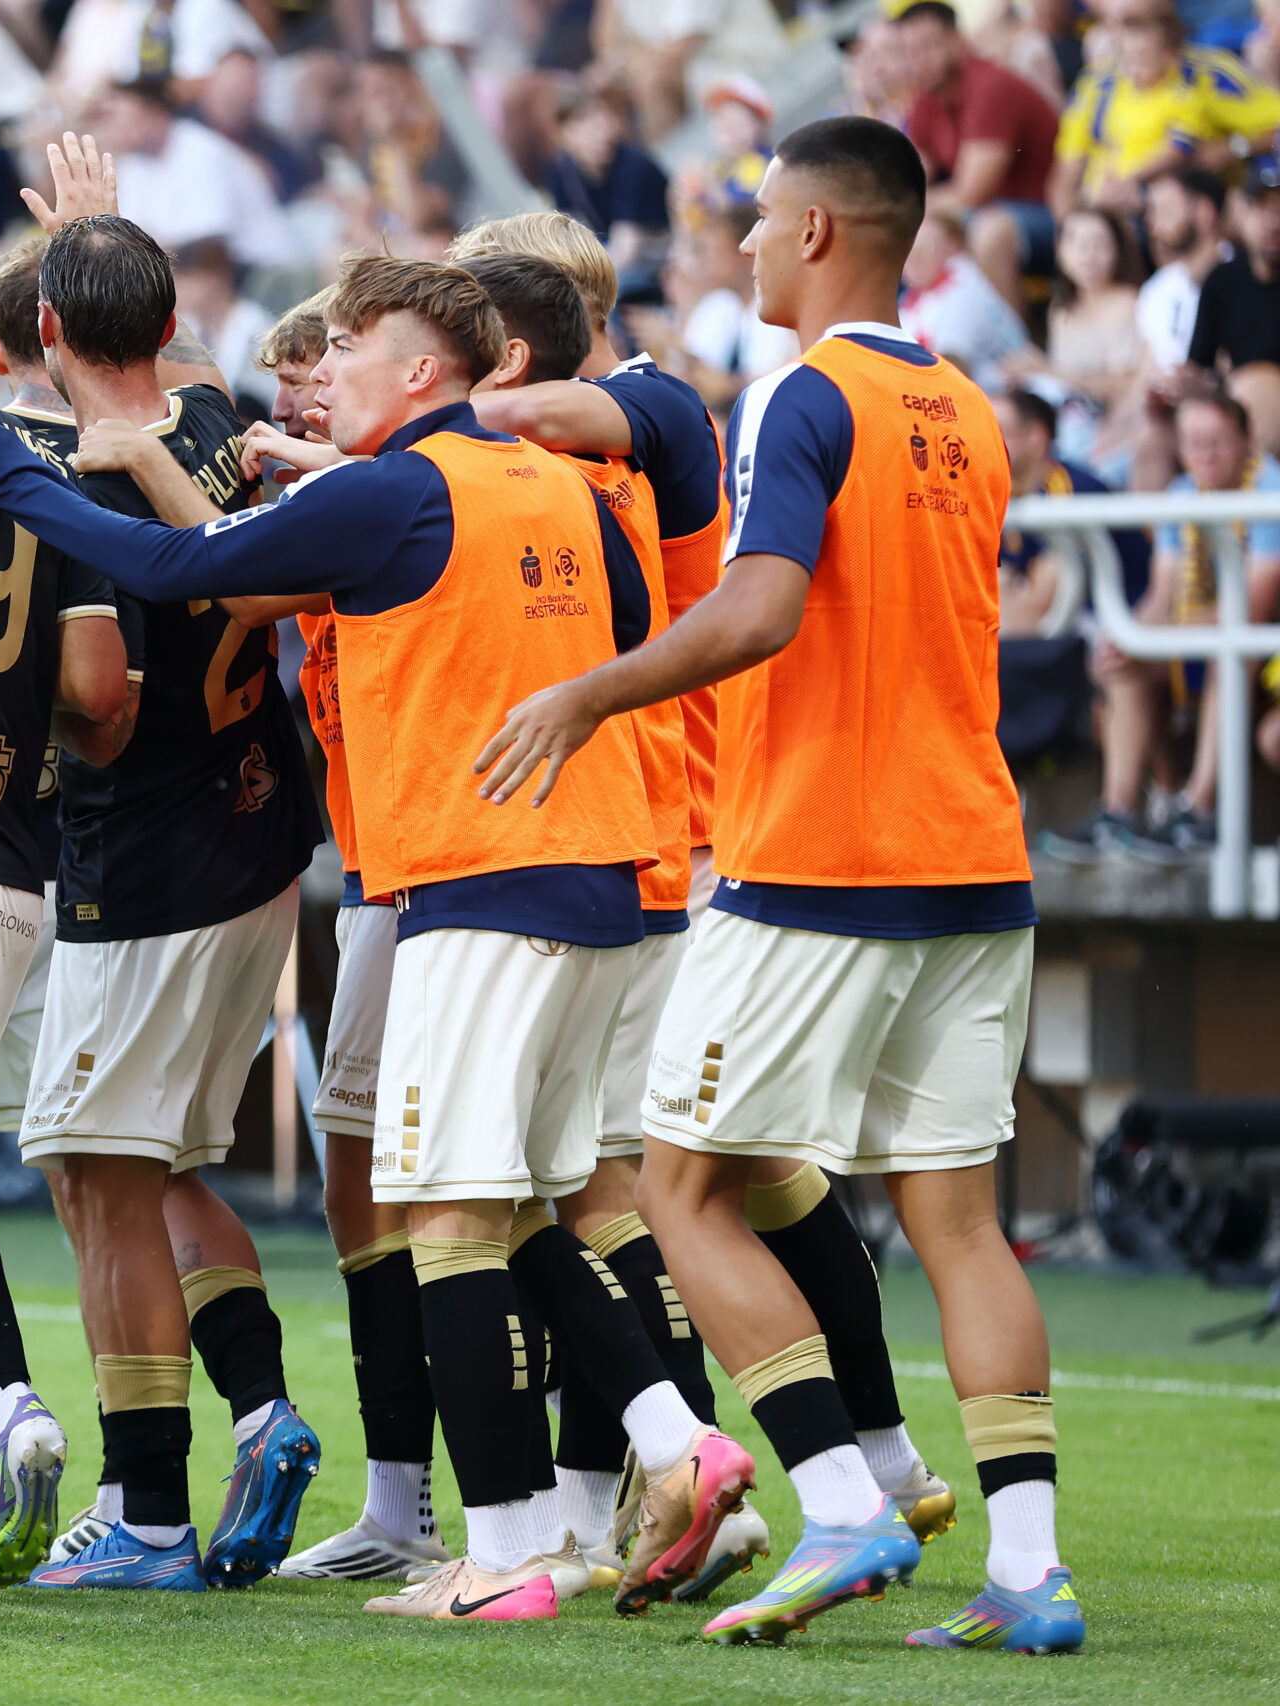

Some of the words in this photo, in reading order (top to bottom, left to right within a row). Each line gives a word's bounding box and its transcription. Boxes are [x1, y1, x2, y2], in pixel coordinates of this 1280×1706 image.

[902, 394, 957, 417] capelli
[595, 479, 634, 508] apelli
[524, 603, 589, 619] EKSTRAKLASA
[329, 1087, 376, 1105] capell
[650, 1089, 692, 1113] capelli
[371, 1152, 397, 1166] pelli
